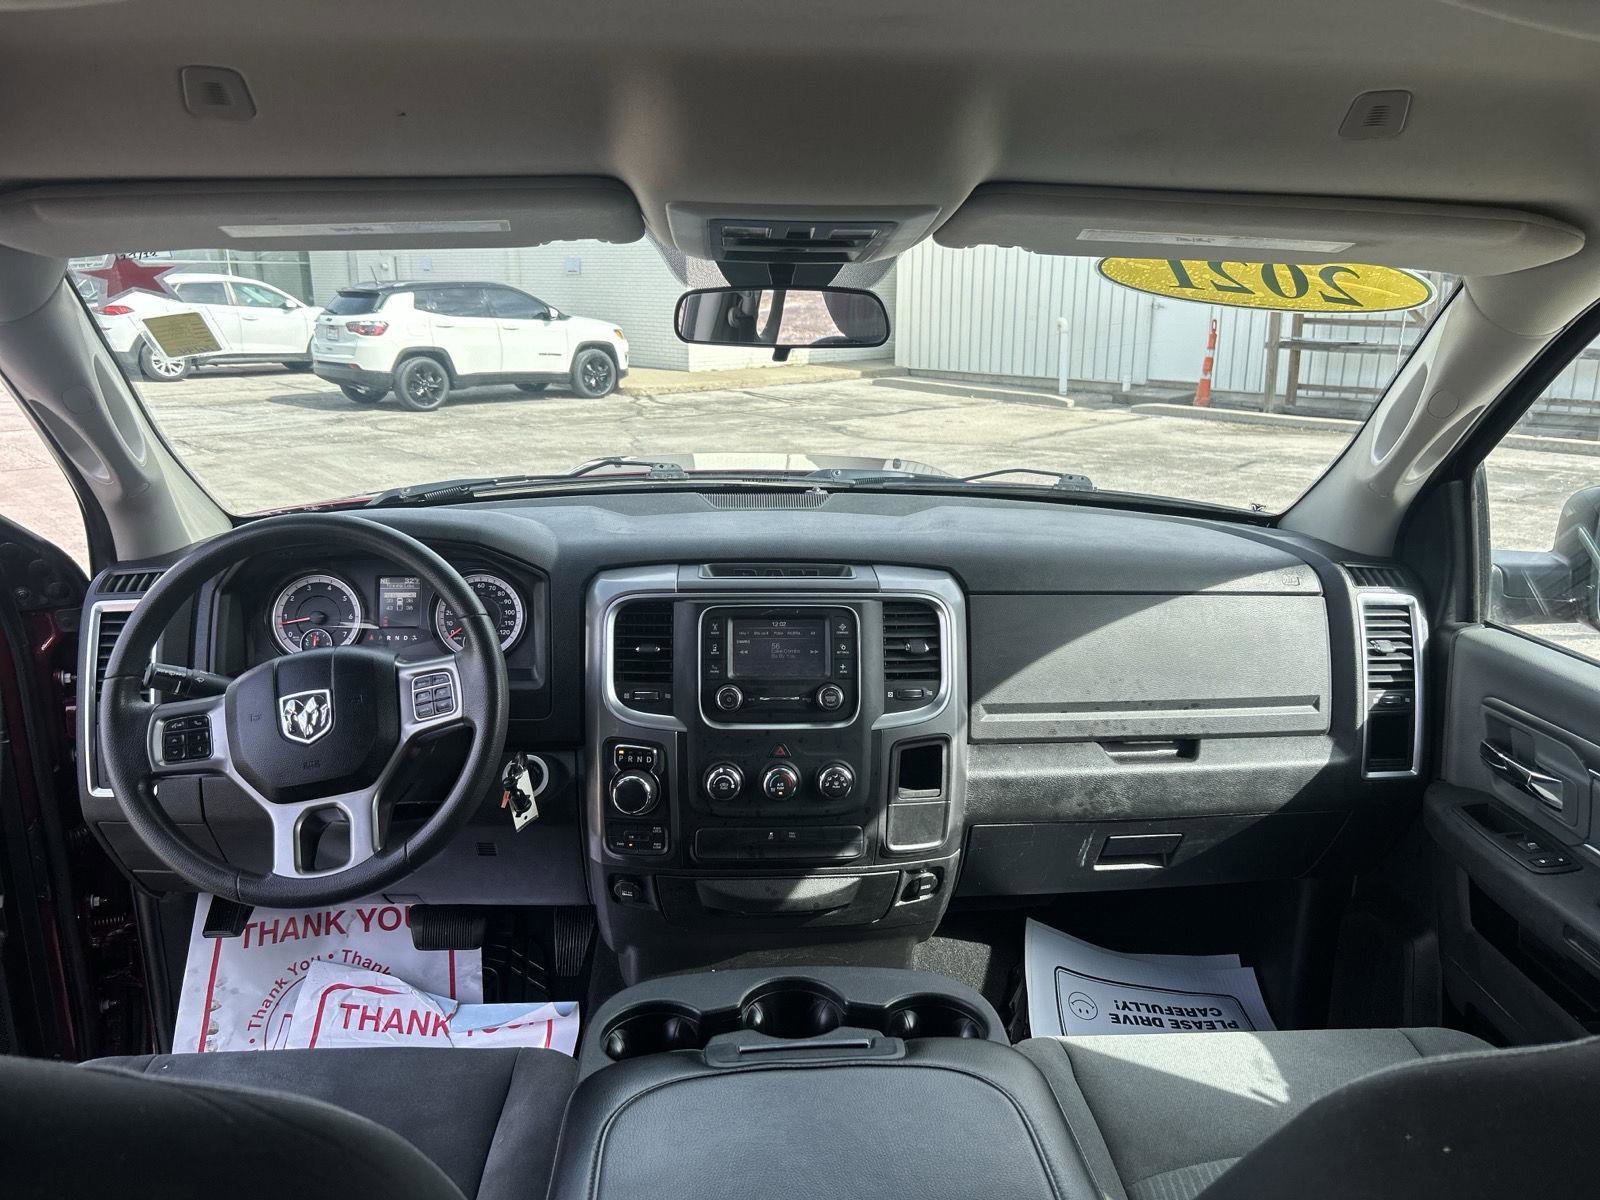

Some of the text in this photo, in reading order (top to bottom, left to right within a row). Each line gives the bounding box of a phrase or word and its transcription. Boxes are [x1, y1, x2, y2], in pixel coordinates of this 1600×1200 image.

[627, 755, 633, 763] R
[242, 909, 347, 949] THANK
[248, 977, 288, 1031] Thank
[1113, 999, 1223, 1018] CAREFULLY!
[339, 1002, 453, 1038] THANK
[1108, 1012, 1241, 1031] PLEASE DRIVE
